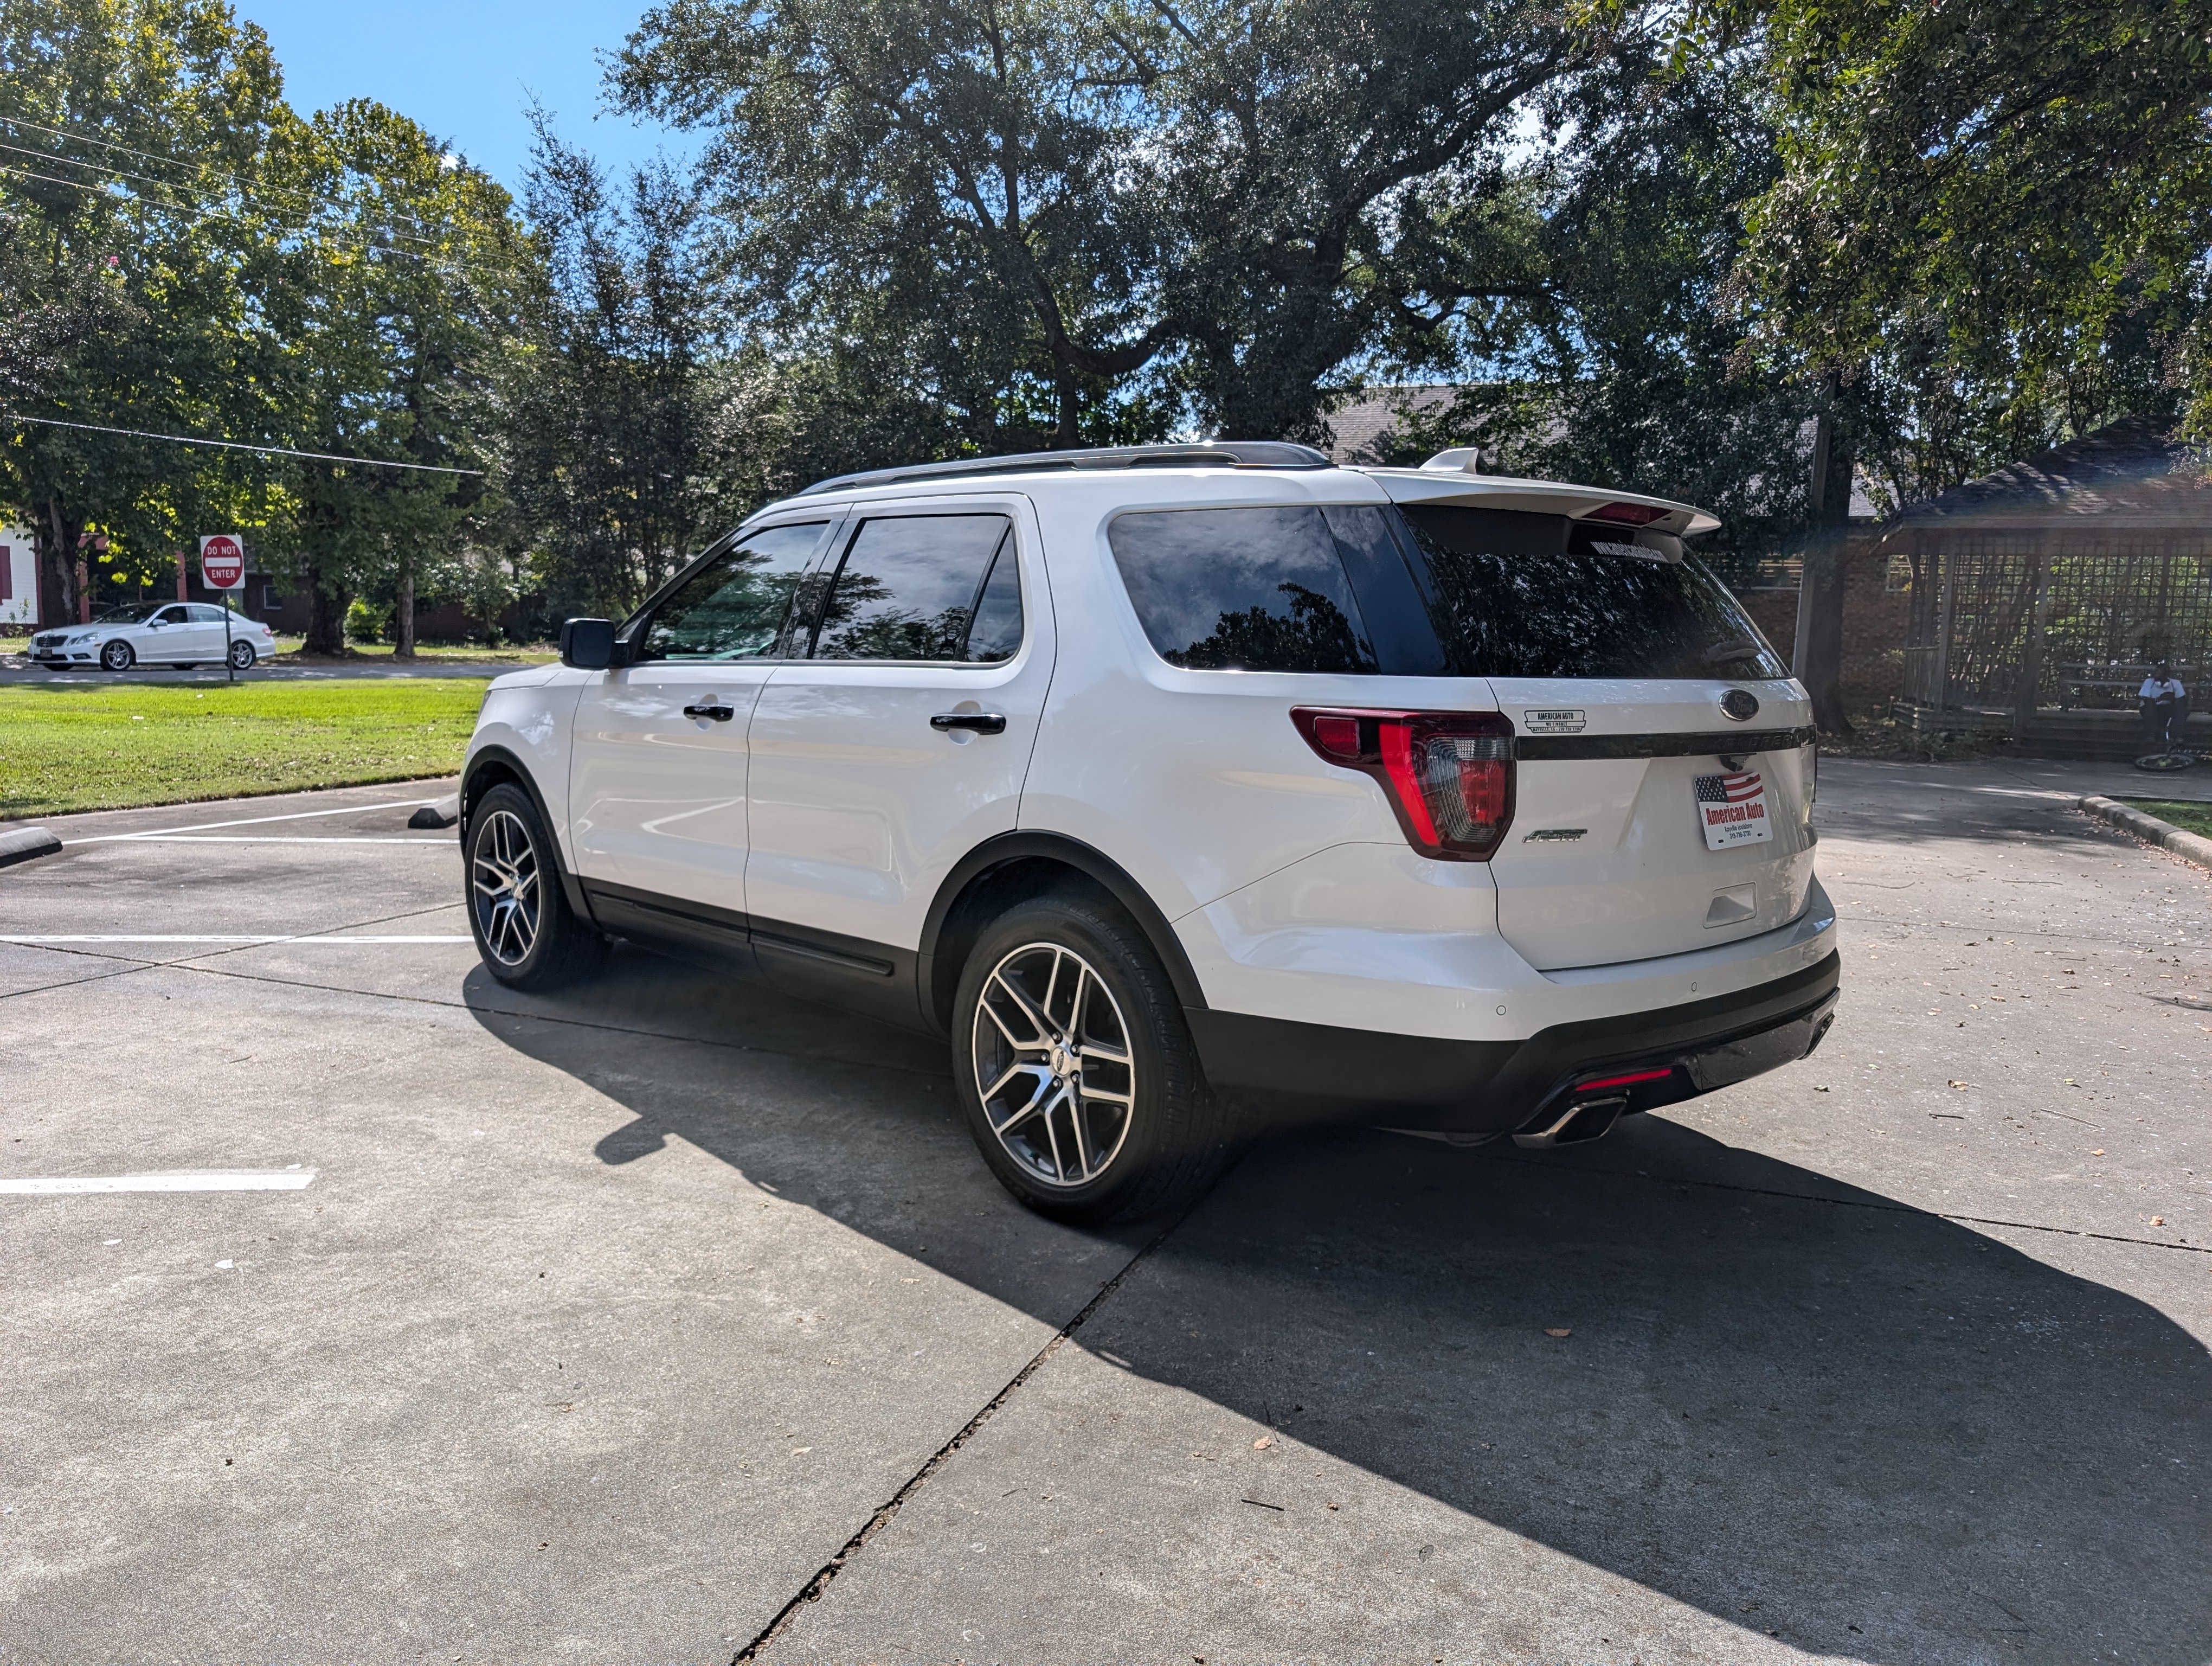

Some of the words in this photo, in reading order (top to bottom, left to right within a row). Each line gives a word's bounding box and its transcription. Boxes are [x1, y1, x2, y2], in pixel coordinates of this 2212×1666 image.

[207, 546, 217, 555] DO
[221, 546, 236, 555] NOT
[211, 569, 235, 579] ENTER
[1706, 805, 1746, 826] American
[1745, 802, 1765, 820] Auto
